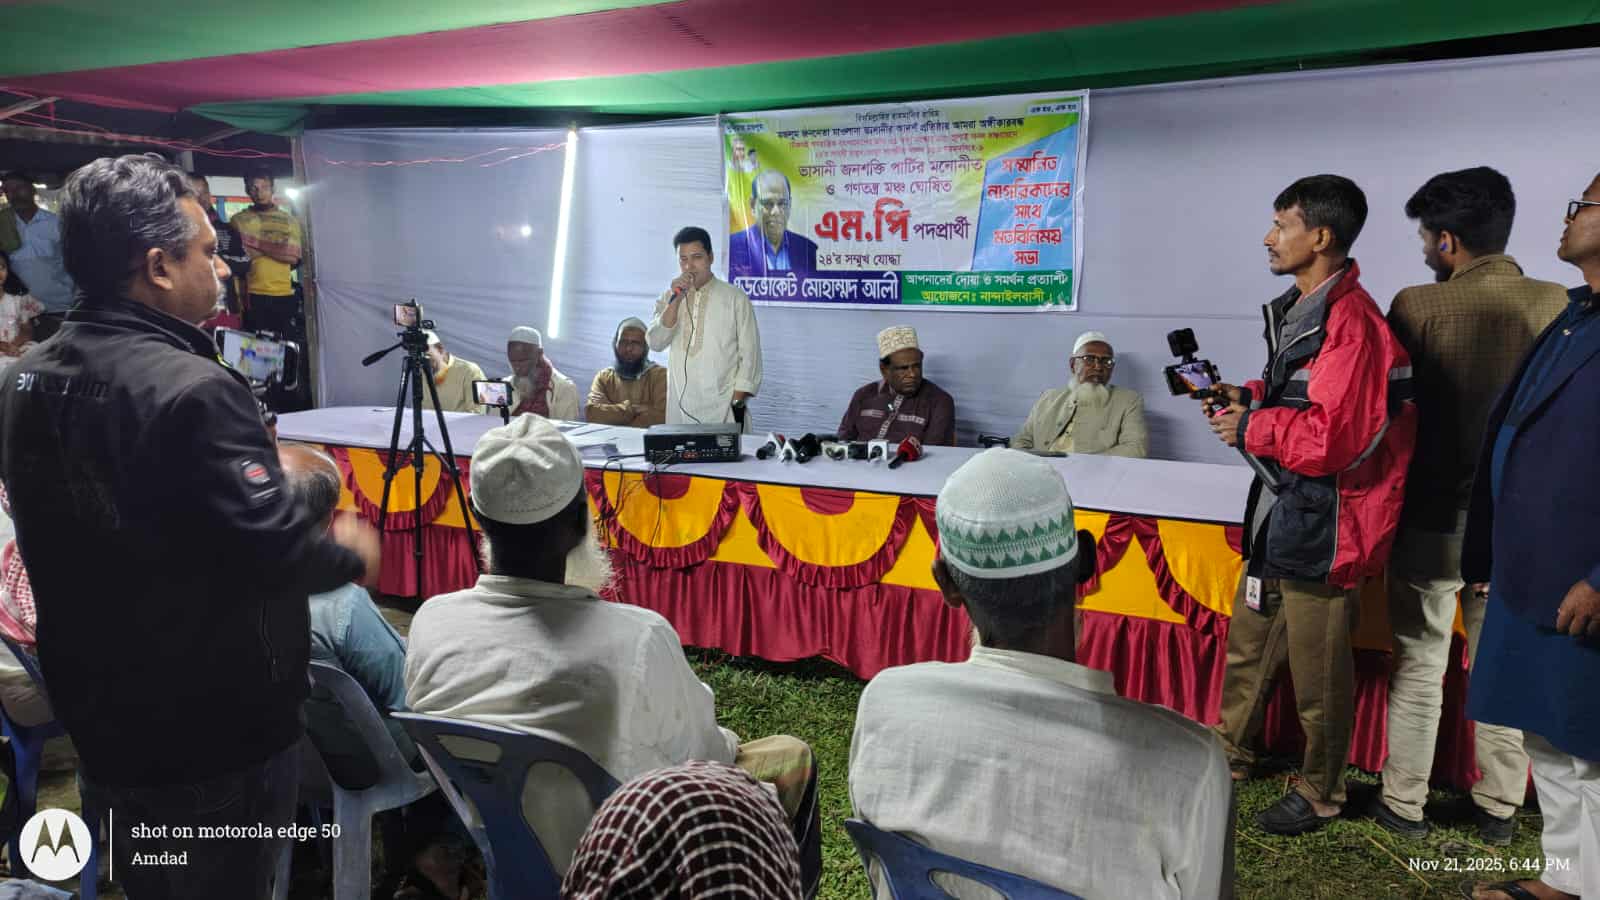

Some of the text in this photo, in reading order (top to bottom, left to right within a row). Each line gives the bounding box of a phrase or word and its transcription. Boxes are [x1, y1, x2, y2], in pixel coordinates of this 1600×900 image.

[798, 160, 836, 176] ভাসানী
[840, 158, 887, 176] জনশক্তি
[928, 154, 984, 173] মনোনীত
[1002, 150, 1058, 173] সম্মানিত
[826, 184, 836, 195] ও
[844, 182, 880, 196] গণতন্ত্র
[910, 176, 953, 195] ঘোষিত
[987, 178, 1071, 198] নাগরিকদের
[814, 198, 971, 242] এম.পি পদপ্রার্থী
[1014, 204, 1042, 219] সাথে
[993, 223, 1062, 245] মতবিনিময়
[844, 254, 870, 268] সম্মুখ
[873, 254, 903, 266] যোদ্ধা
[1014, 250, 1039, 265] সভা
[801, 277, 858, 299] মোহাম্মদ
[861, 272, 900, 300] আলী
[905, 273, 953, 287] আপনাদের
[994, 272, 1025, 286] সমর্থন
